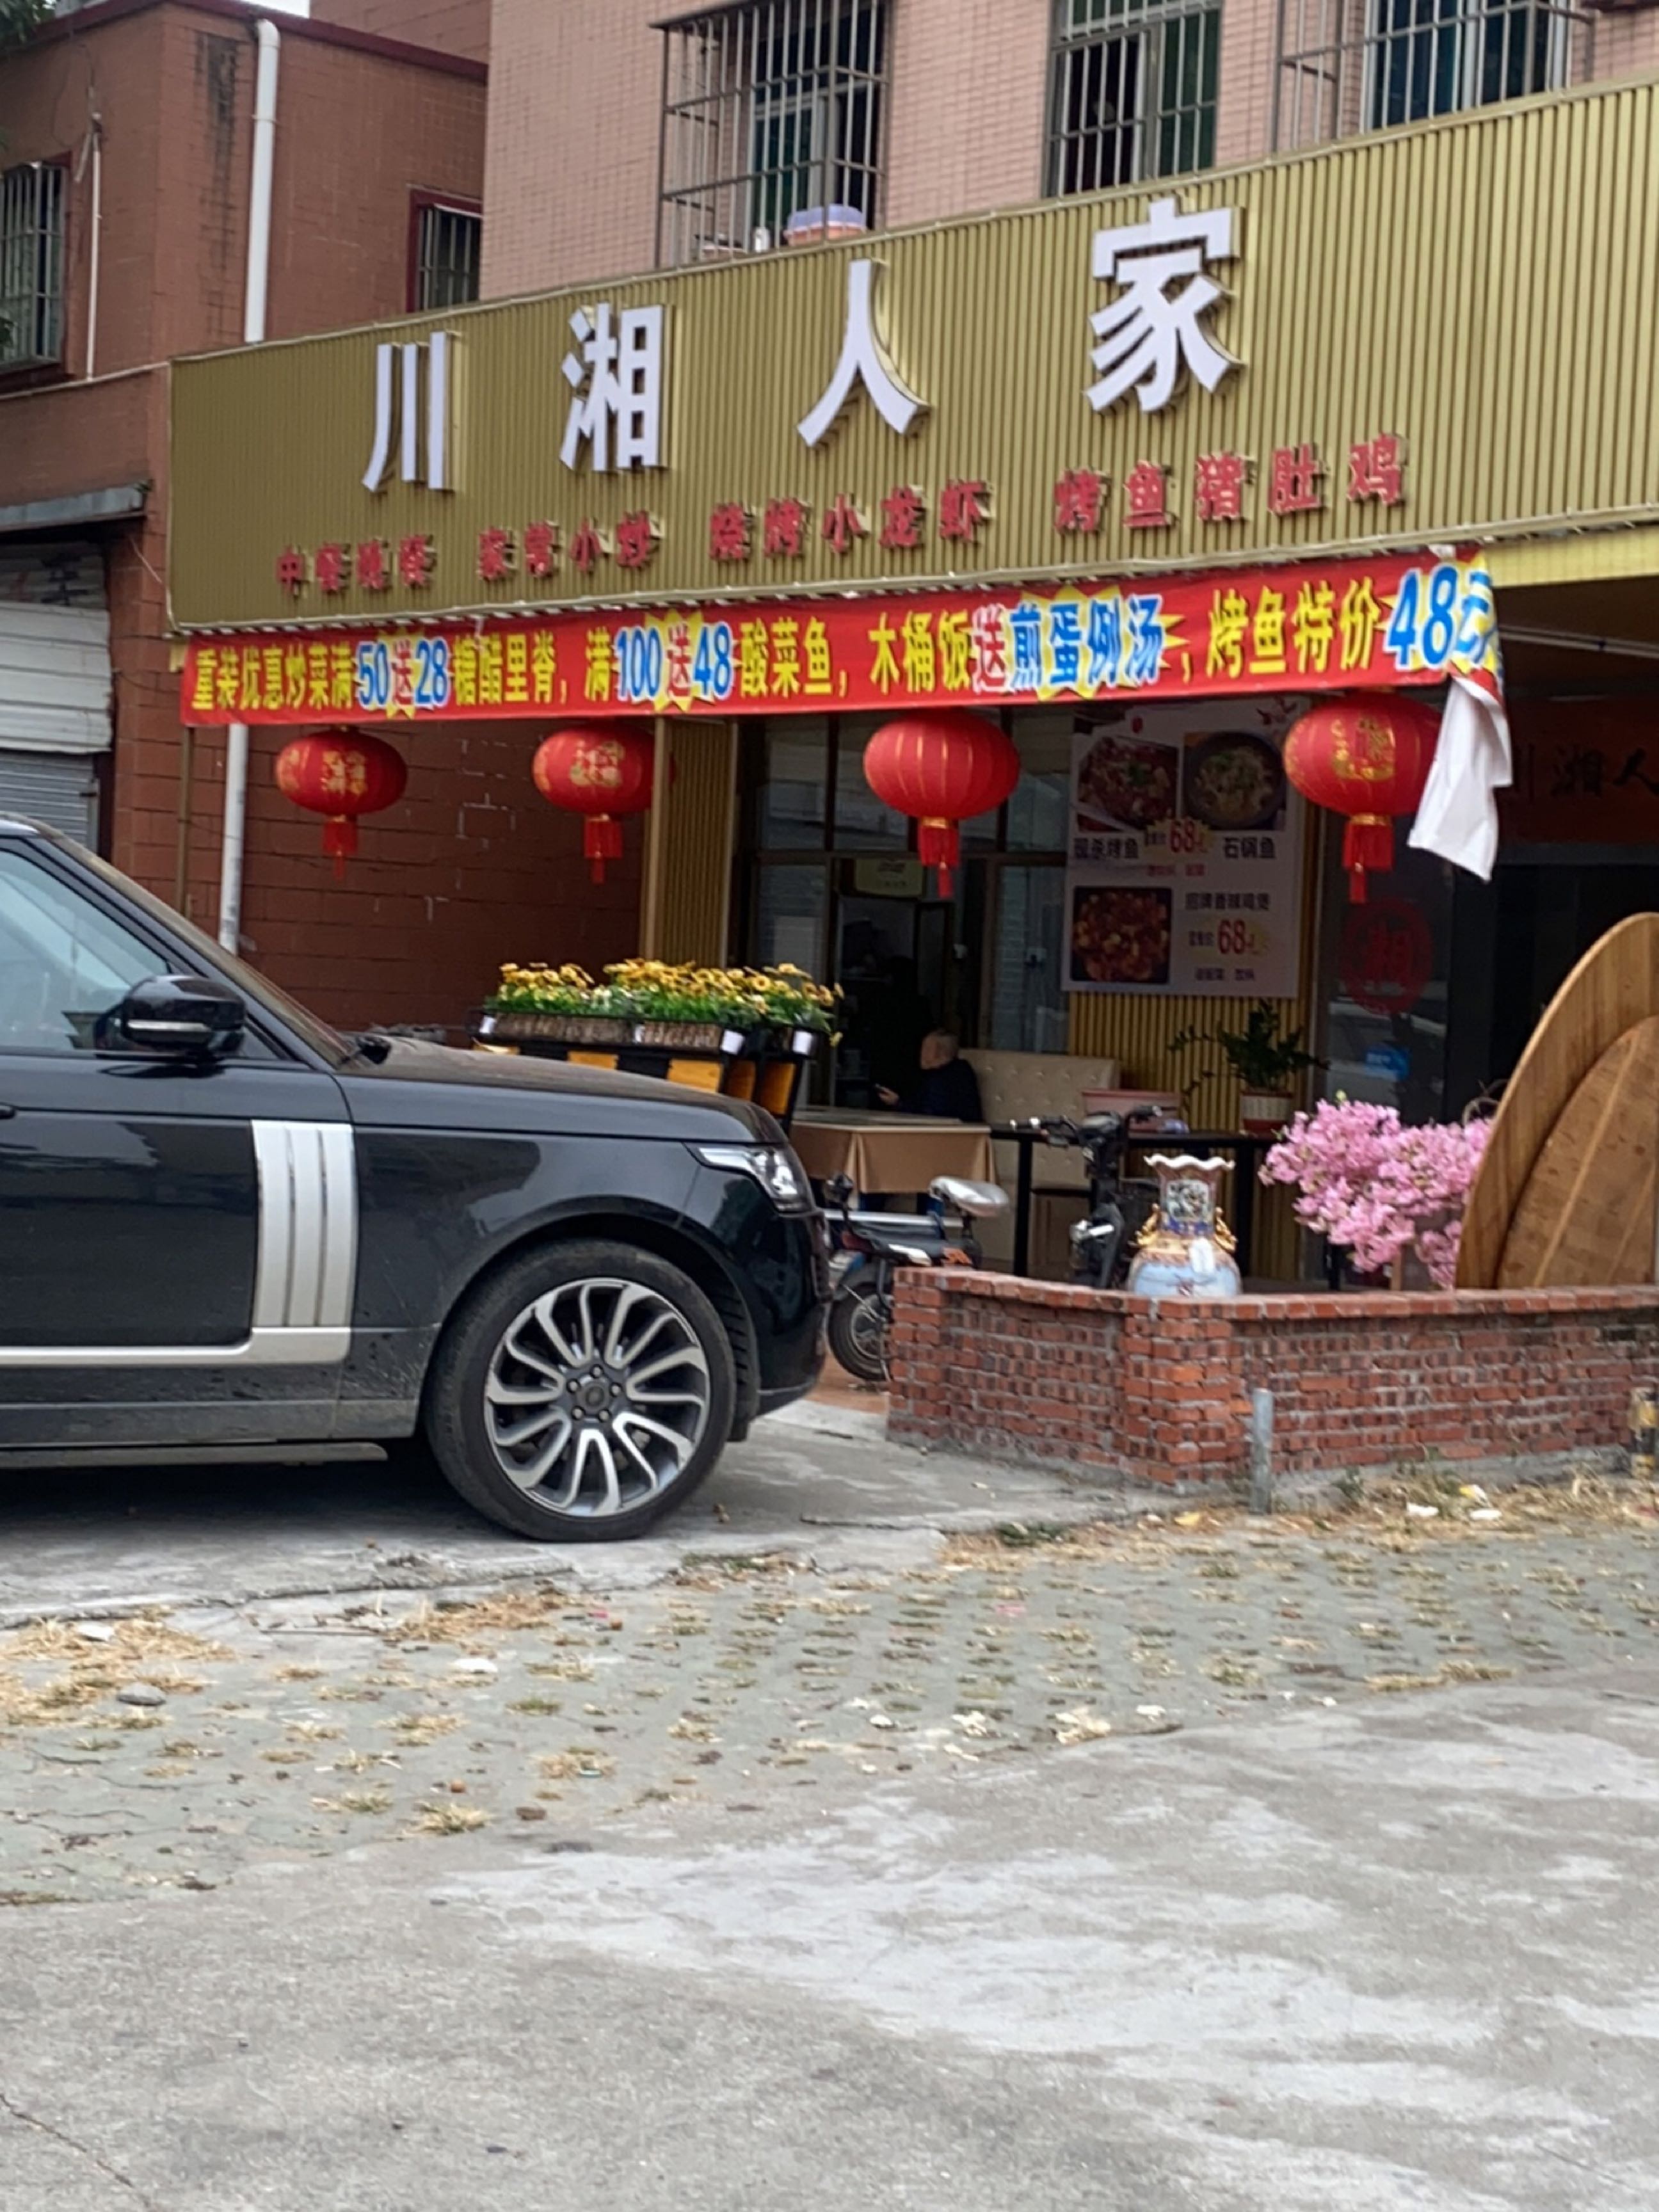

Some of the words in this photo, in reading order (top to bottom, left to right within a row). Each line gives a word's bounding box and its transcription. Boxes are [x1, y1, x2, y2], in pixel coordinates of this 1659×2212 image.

[361, 196, 1243, 494] 川湘人家
[1055, 433, 1403, 533] 烤鱼猪肚鸡
